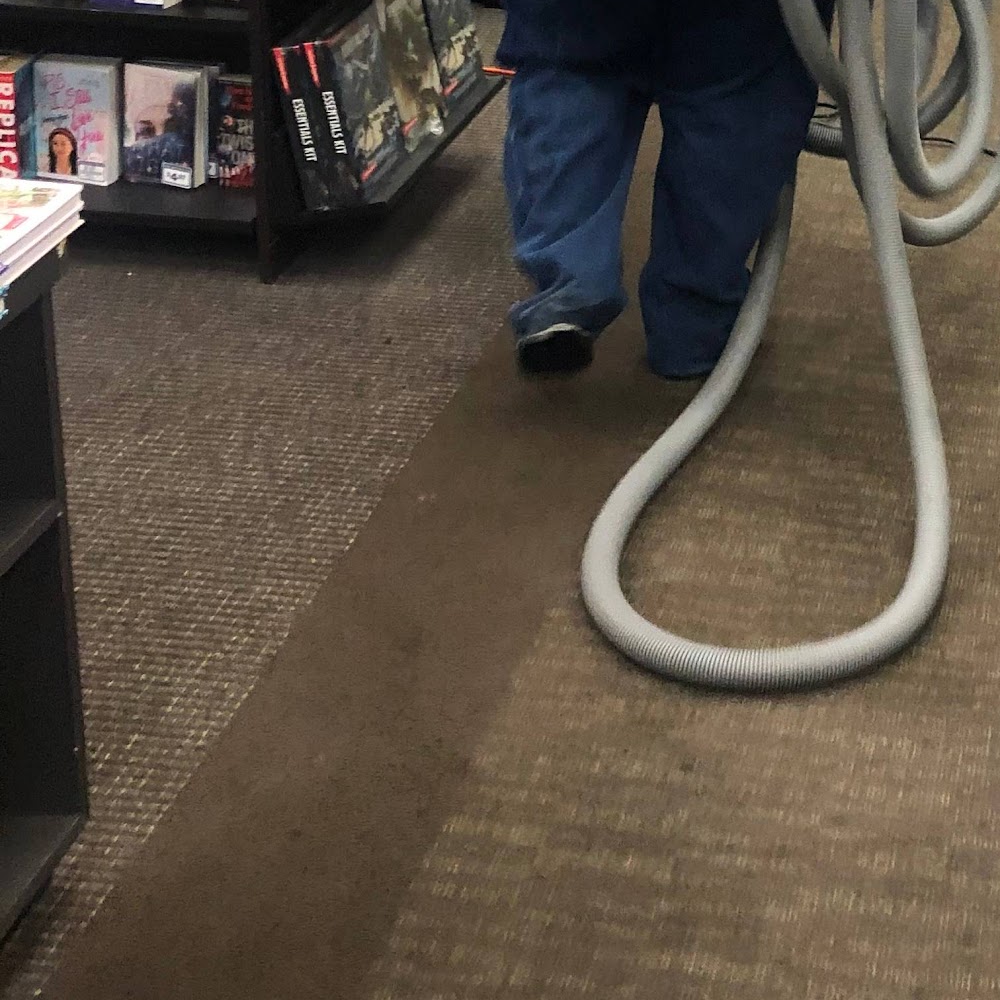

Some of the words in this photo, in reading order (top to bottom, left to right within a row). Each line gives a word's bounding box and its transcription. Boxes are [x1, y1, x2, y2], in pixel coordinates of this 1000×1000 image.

[292, 98, 313, 147] ESSENTIALS
[303, 147, 318, 162] KIT
[321, 91, 343, 140] ESSENTIALS
[333, 140, 347, 155] KIT
